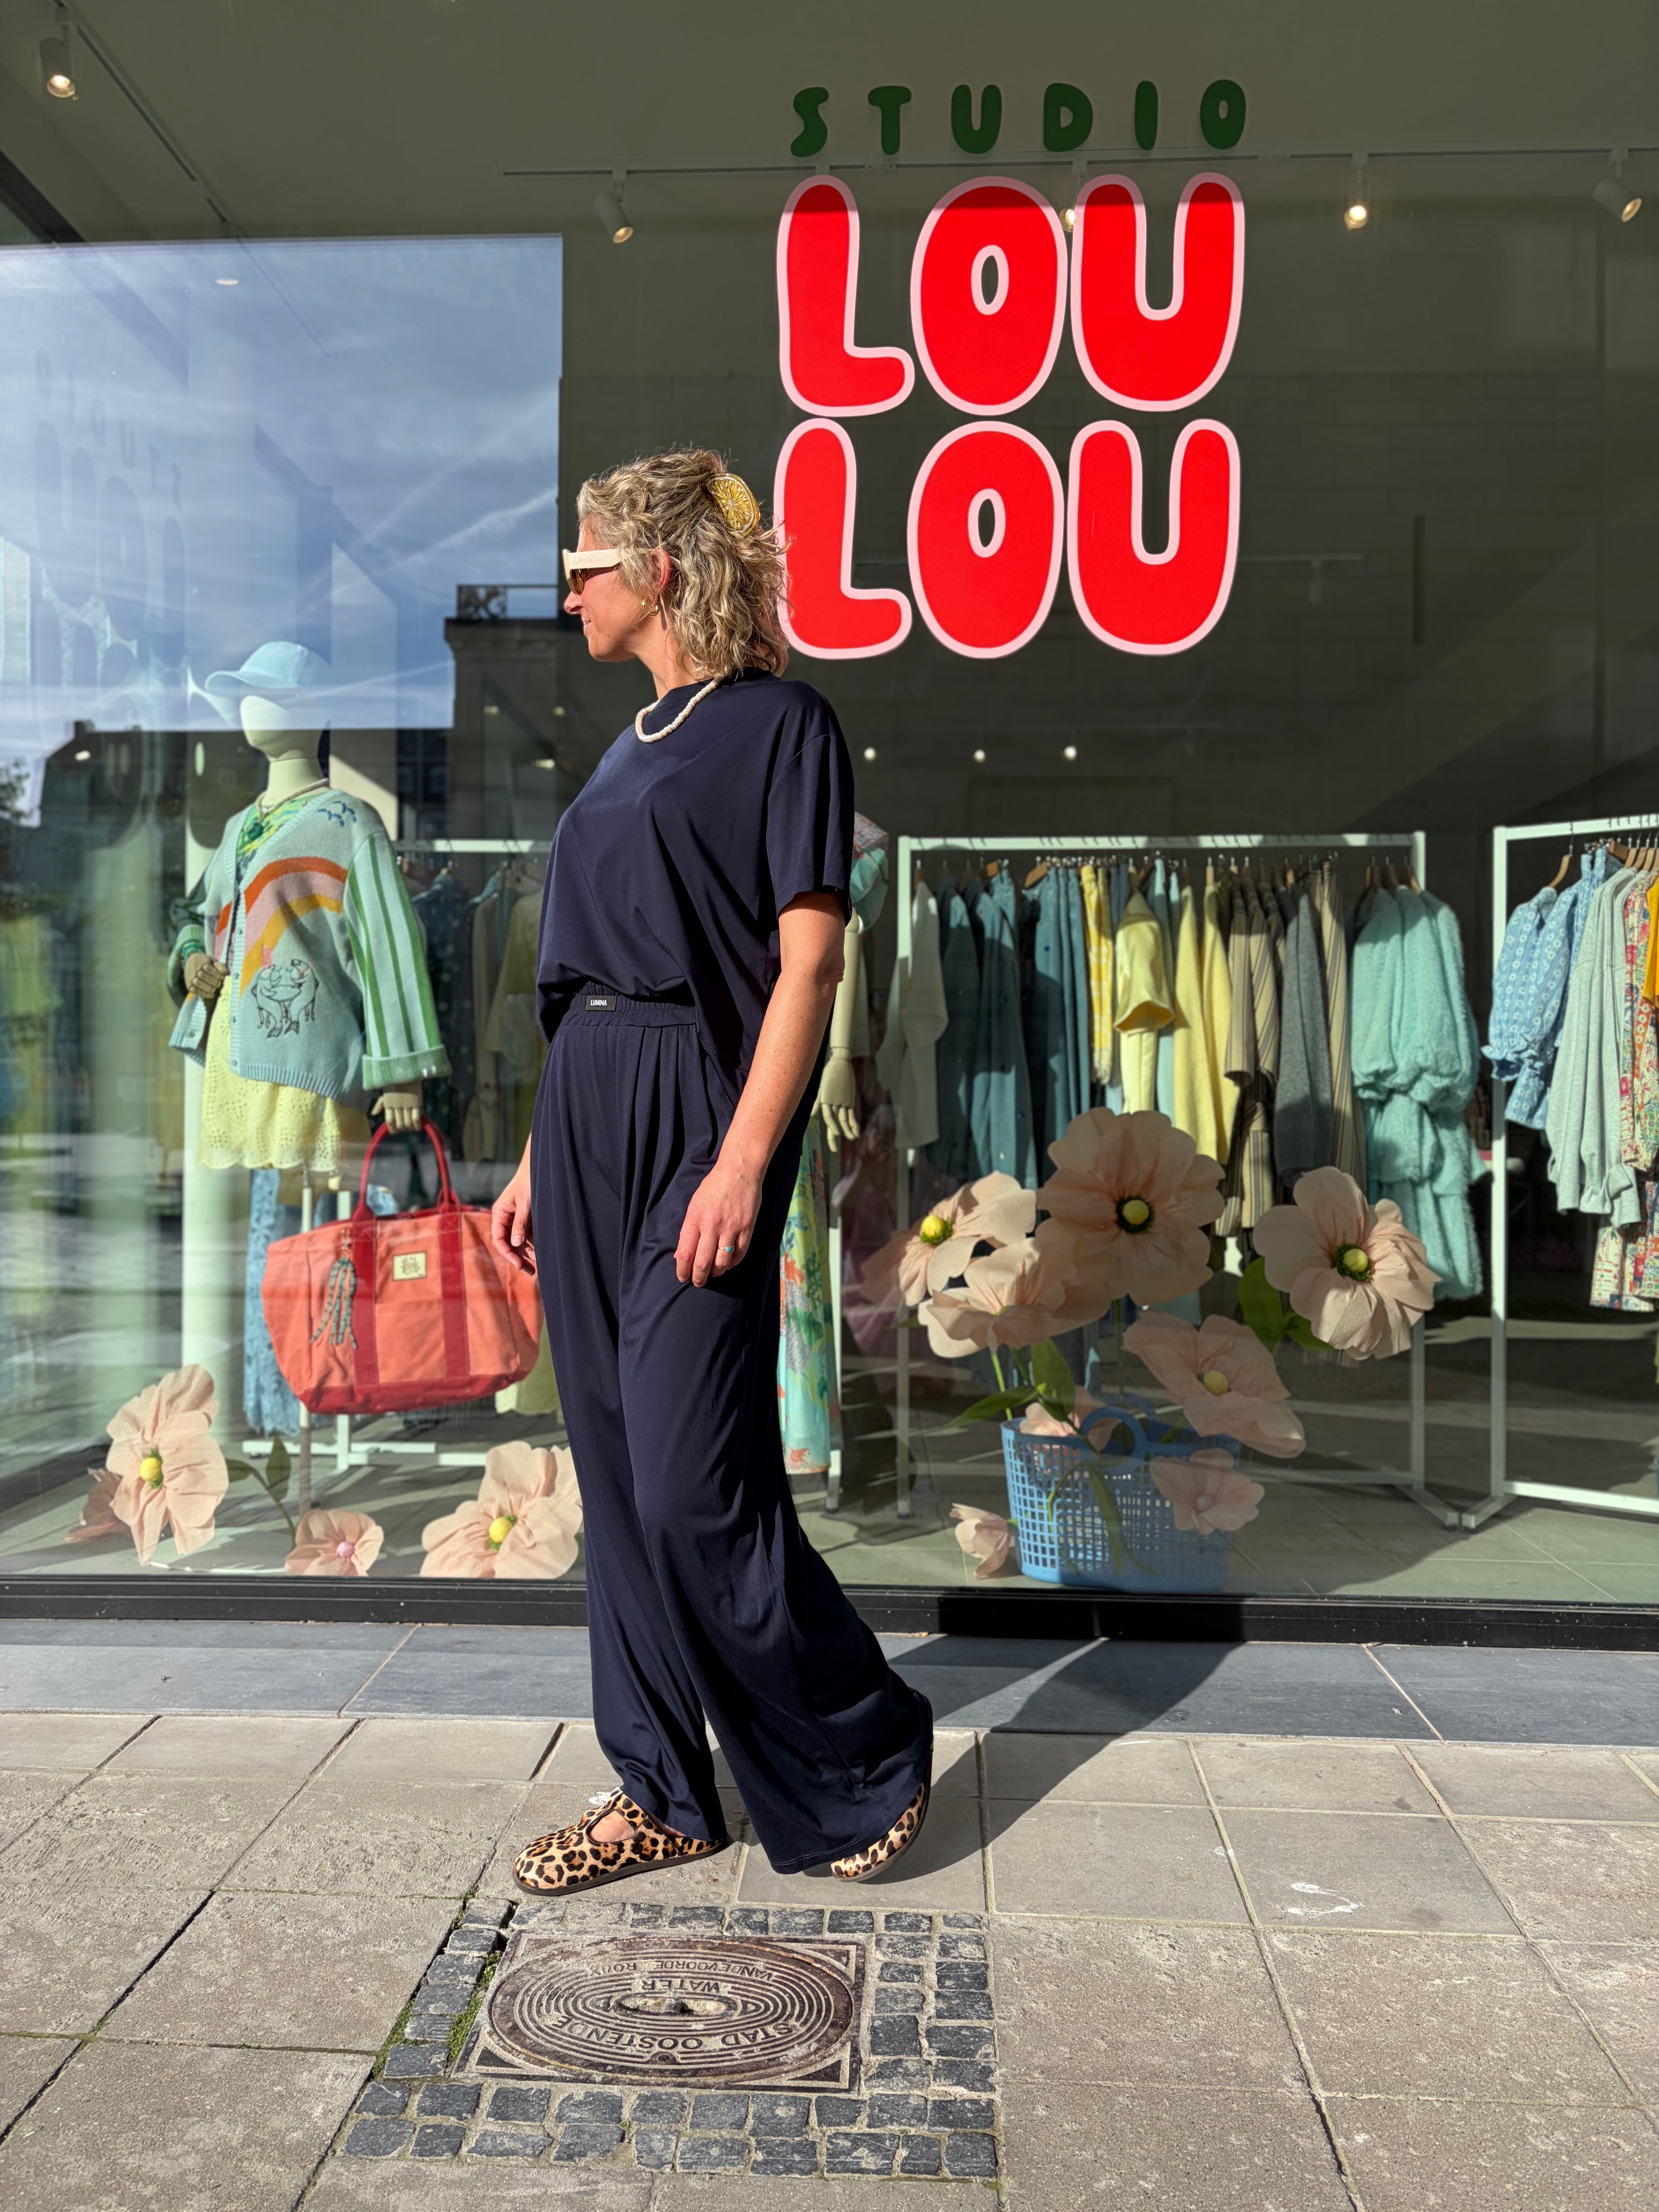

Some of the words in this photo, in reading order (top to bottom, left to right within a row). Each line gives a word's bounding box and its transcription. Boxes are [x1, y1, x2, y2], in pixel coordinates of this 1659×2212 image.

[790, 79, 1246, 157] STUDIO
[777, 173, 1245, 416] LOU
[773, 418, 1240, 659] LOU
[642, 1979, 720, 1993] WATER
[655, 1960, 773, 1981] VANDEVOORDE
[551, 2015, 703, 2050] OOSTENDE
[721, 2024, 794, 2046] STAD
